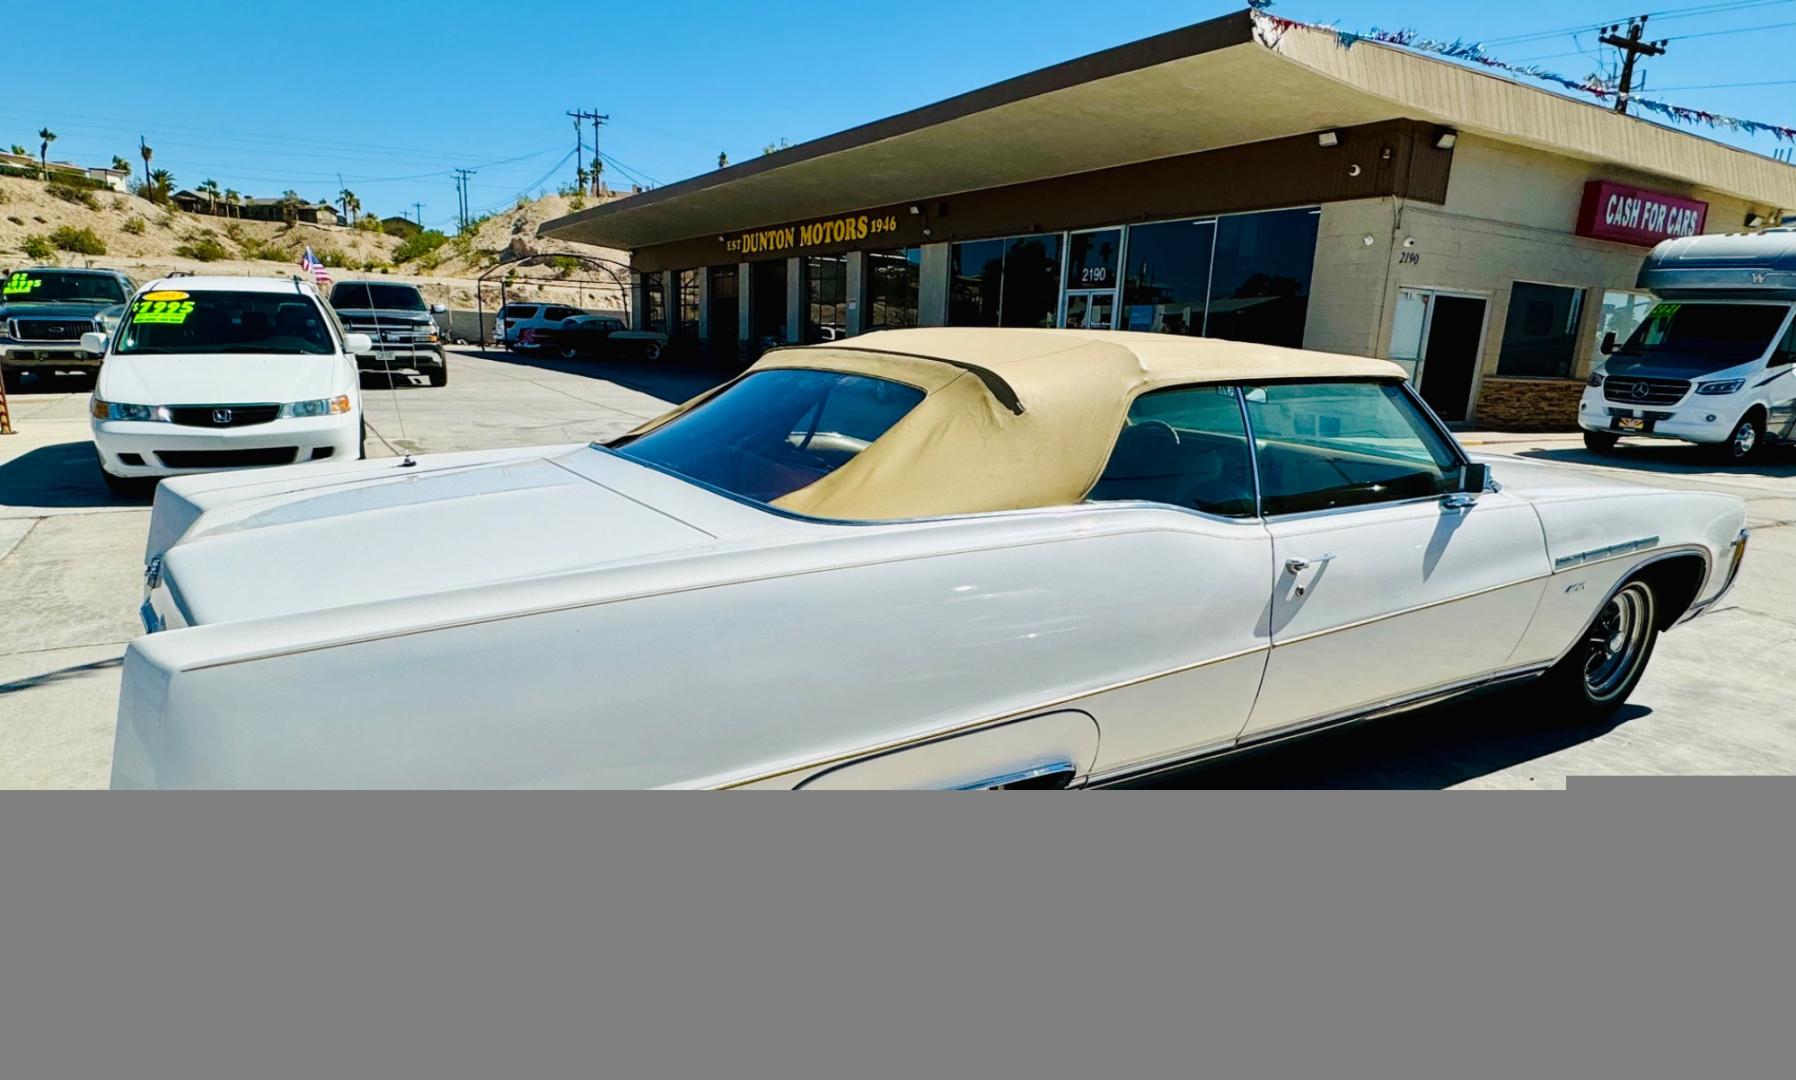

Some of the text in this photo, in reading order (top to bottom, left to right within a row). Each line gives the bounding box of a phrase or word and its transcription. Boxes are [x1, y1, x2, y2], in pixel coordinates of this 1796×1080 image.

[1606, 194, 1698, 237] CASH FOR CARS
[727, 216, 897, 253] EST DUNTON MOTORS 1946
[1399, 251, 1420, 265] 2190
[1082, 267, 1107, 282] 2190
